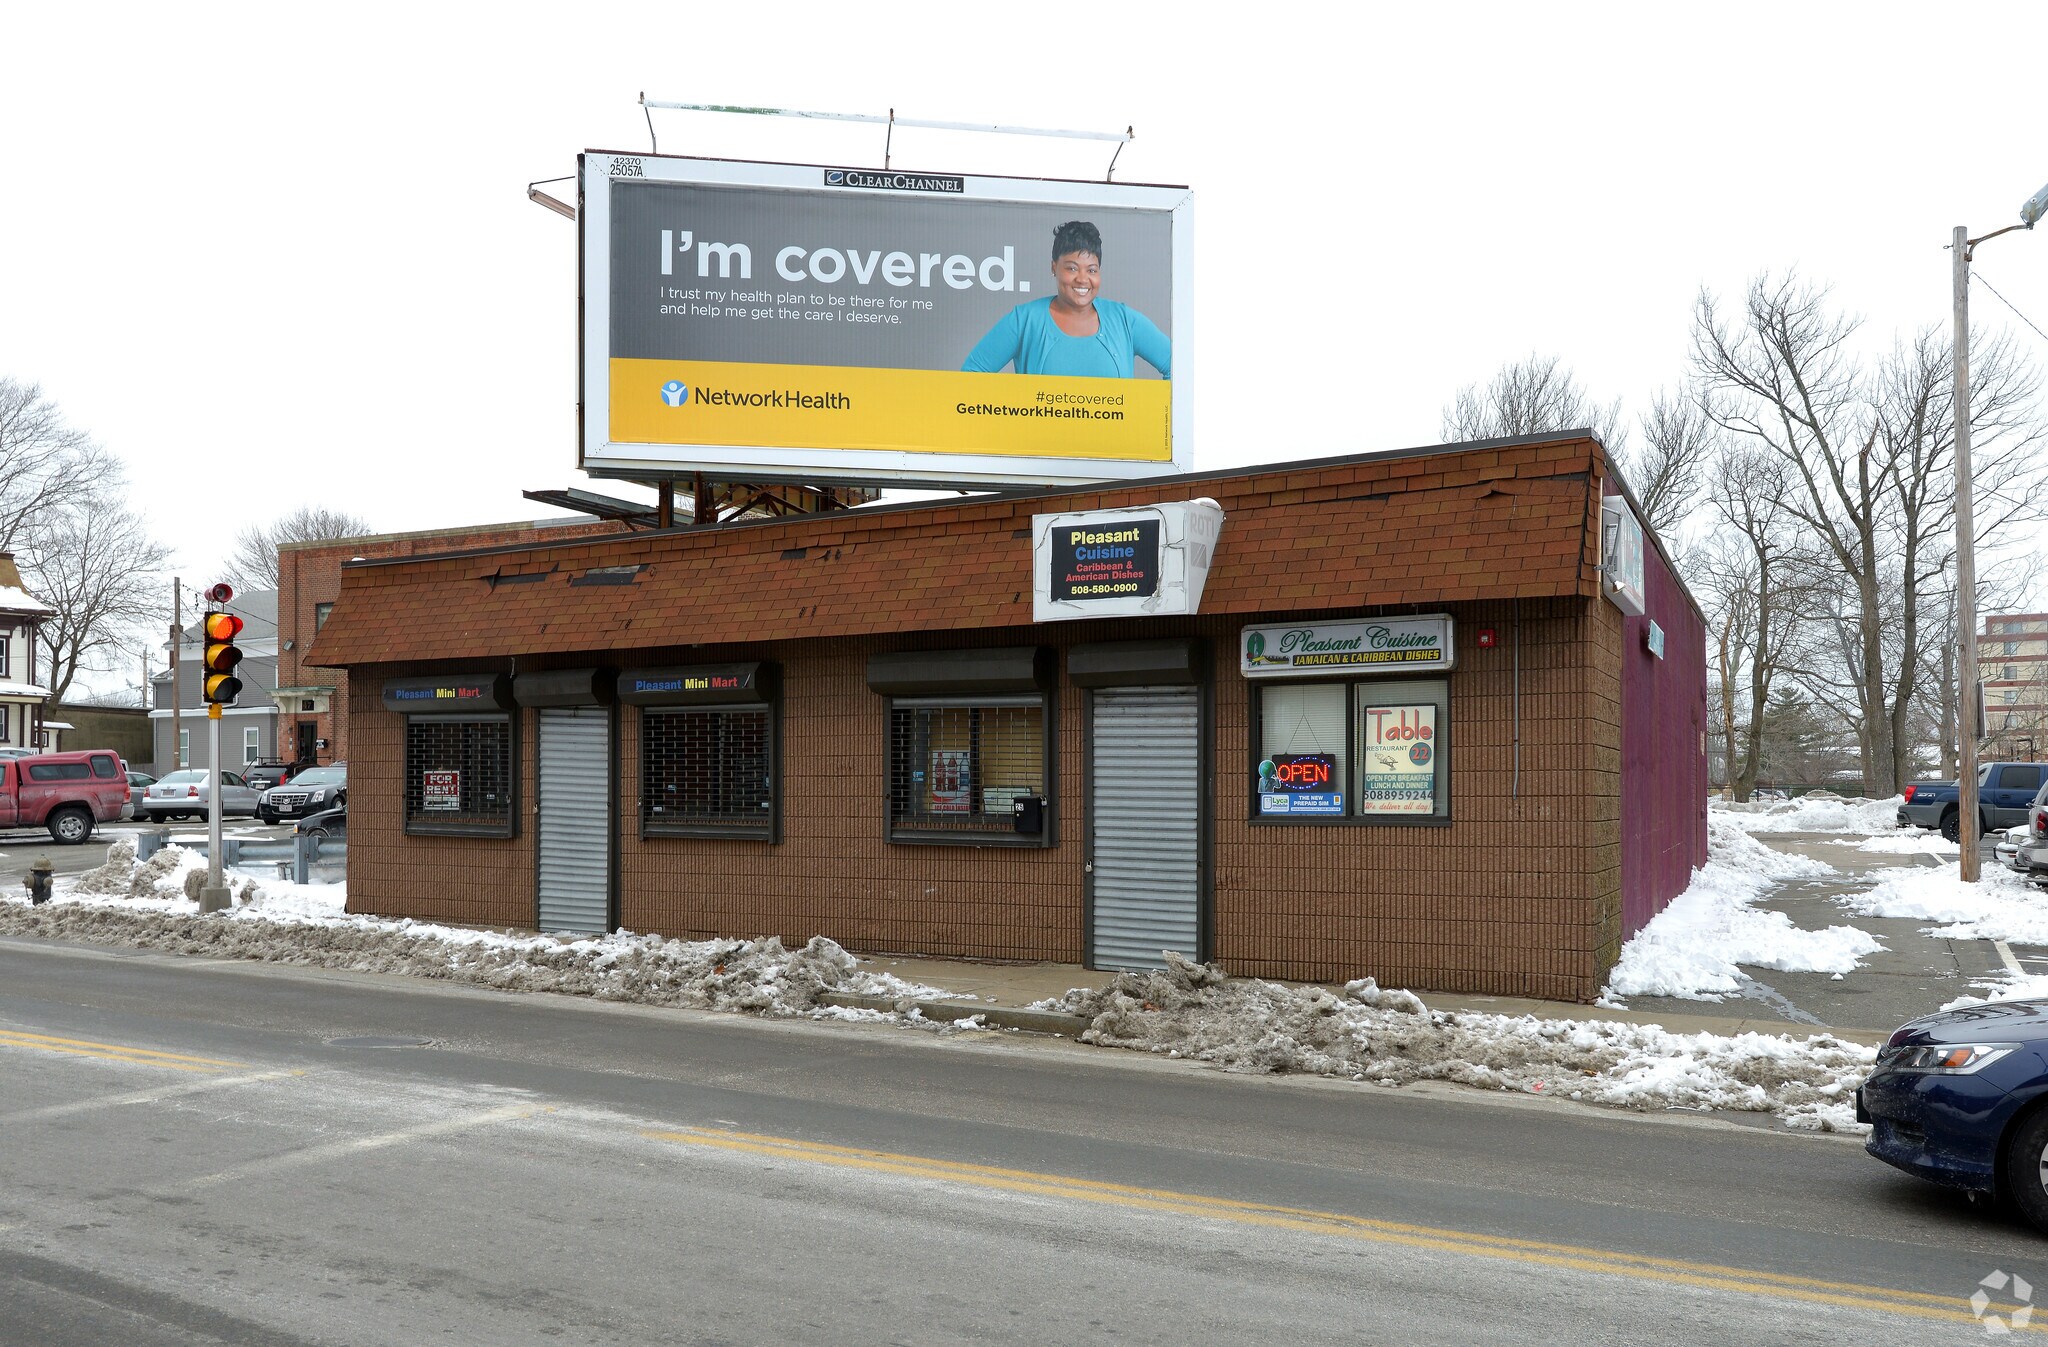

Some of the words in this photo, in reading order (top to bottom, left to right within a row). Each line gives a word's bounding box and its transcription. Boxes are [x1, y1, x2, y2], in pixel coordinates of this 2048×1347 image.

[613, 156, 641, 165] 42370
[610, 163, 643, 177] 25057A
[661, 229, 752, 279] I'm
[775, 245, 1031, 292] covered.
[660, 286, 664, 298] I
[668, 288, 700, 300] trust
[705, 291, 726, 303] my
[731, 289, 773, 304] health
[777, 291, 805, 308] plan
[810, 293, 824, 304] to
[828, 292, 846, 306] be
[850, 292, 885, 308] there
[889, 295, 908, 309] for
[911, 299, 933, 311] me
[660, 303, 686, 315] and
[691, 304, 721, 320] help
[725, 307, 747, 318] me
[751, 306, 774, 321] get
[778, 306, 800, 320] the
[804, 310, 833, 322] care
[846, 310, 902, 325] deserve.
[1036, 390, 1124, 406] #getcovered
[956, 403, 1124, 421] GetNetworkHealth.com
[1071, 528, 1140, 545] Pleasant
[1075, 546, 1135, 561] Cuisine
[1076, 562, 1123, 572] Caribbean
[1126, 560, 1133, 570] &
[1065, 571, 1109, 582] American
[1112, 570, 1144, 580] Dishes
[1071, 583, 1138, 595] 508-580-0900
[1279, 629, 1361, 653] Pleasant
[1366, 625, 1437, 649] Cuisine
[1294, 654, 1341, 666] JAMAICAN
[1342, 653, 1349, 663] &
[1351, 651, 1403, 663] CARIBBEAN
[1406, 649, 1439, 661] DISHES
[635, 679, 682, 690] Pleasant
[685, 678, 708, 689] Mini
[712, 676, 738, 688] Mart
[396, 688, 434, 699] Pleasant
[436, 688, 456, 698] Mini
[458, 687, 480, 697] Mart
[1367, 709, 1433, 744] Table
[1412, 748, 1428, 760] 22
[430, 775, 452, 784] FOR
[1277, 764, 1329, 782] OPEN
[427, 785, 456, 794] RENT
[1406, 781, 1429, 789] DINNER
[1364, 790, 1433, 800] 5088959244
[1365, 802, 1376, 810] We
[1379, 802, 1401, 810] deliver
[1403, 801, 1414, 810] all
[1416, 802, 1432, 812] day!
